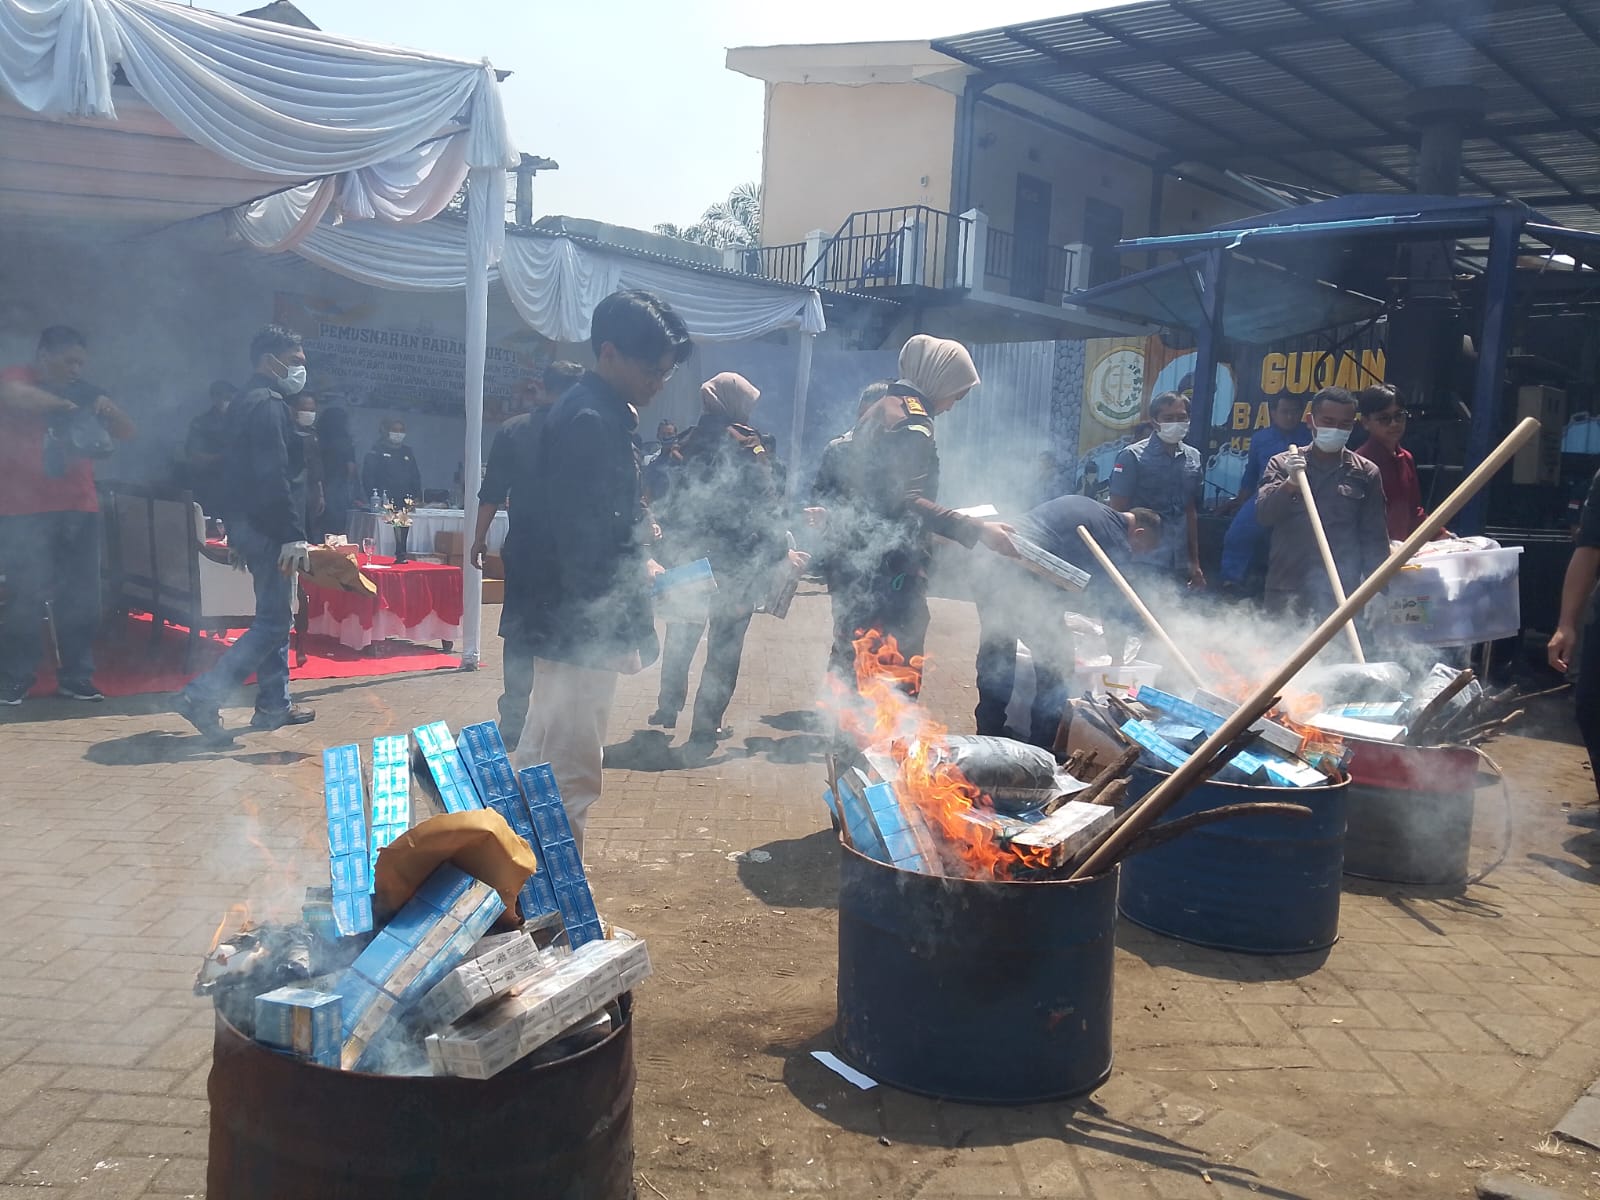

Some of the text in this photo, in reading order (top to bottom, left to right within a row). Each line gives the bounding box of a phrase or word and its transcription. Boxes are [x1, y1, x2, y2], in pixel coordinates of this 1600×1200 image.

[319, 323, 419, 348] PEMUSNAHAN
[421, 336, 467, 355] BARAN
[486, 346, 517, 362] UKTI
[1261, 349, 1386, 394] GUDAN
